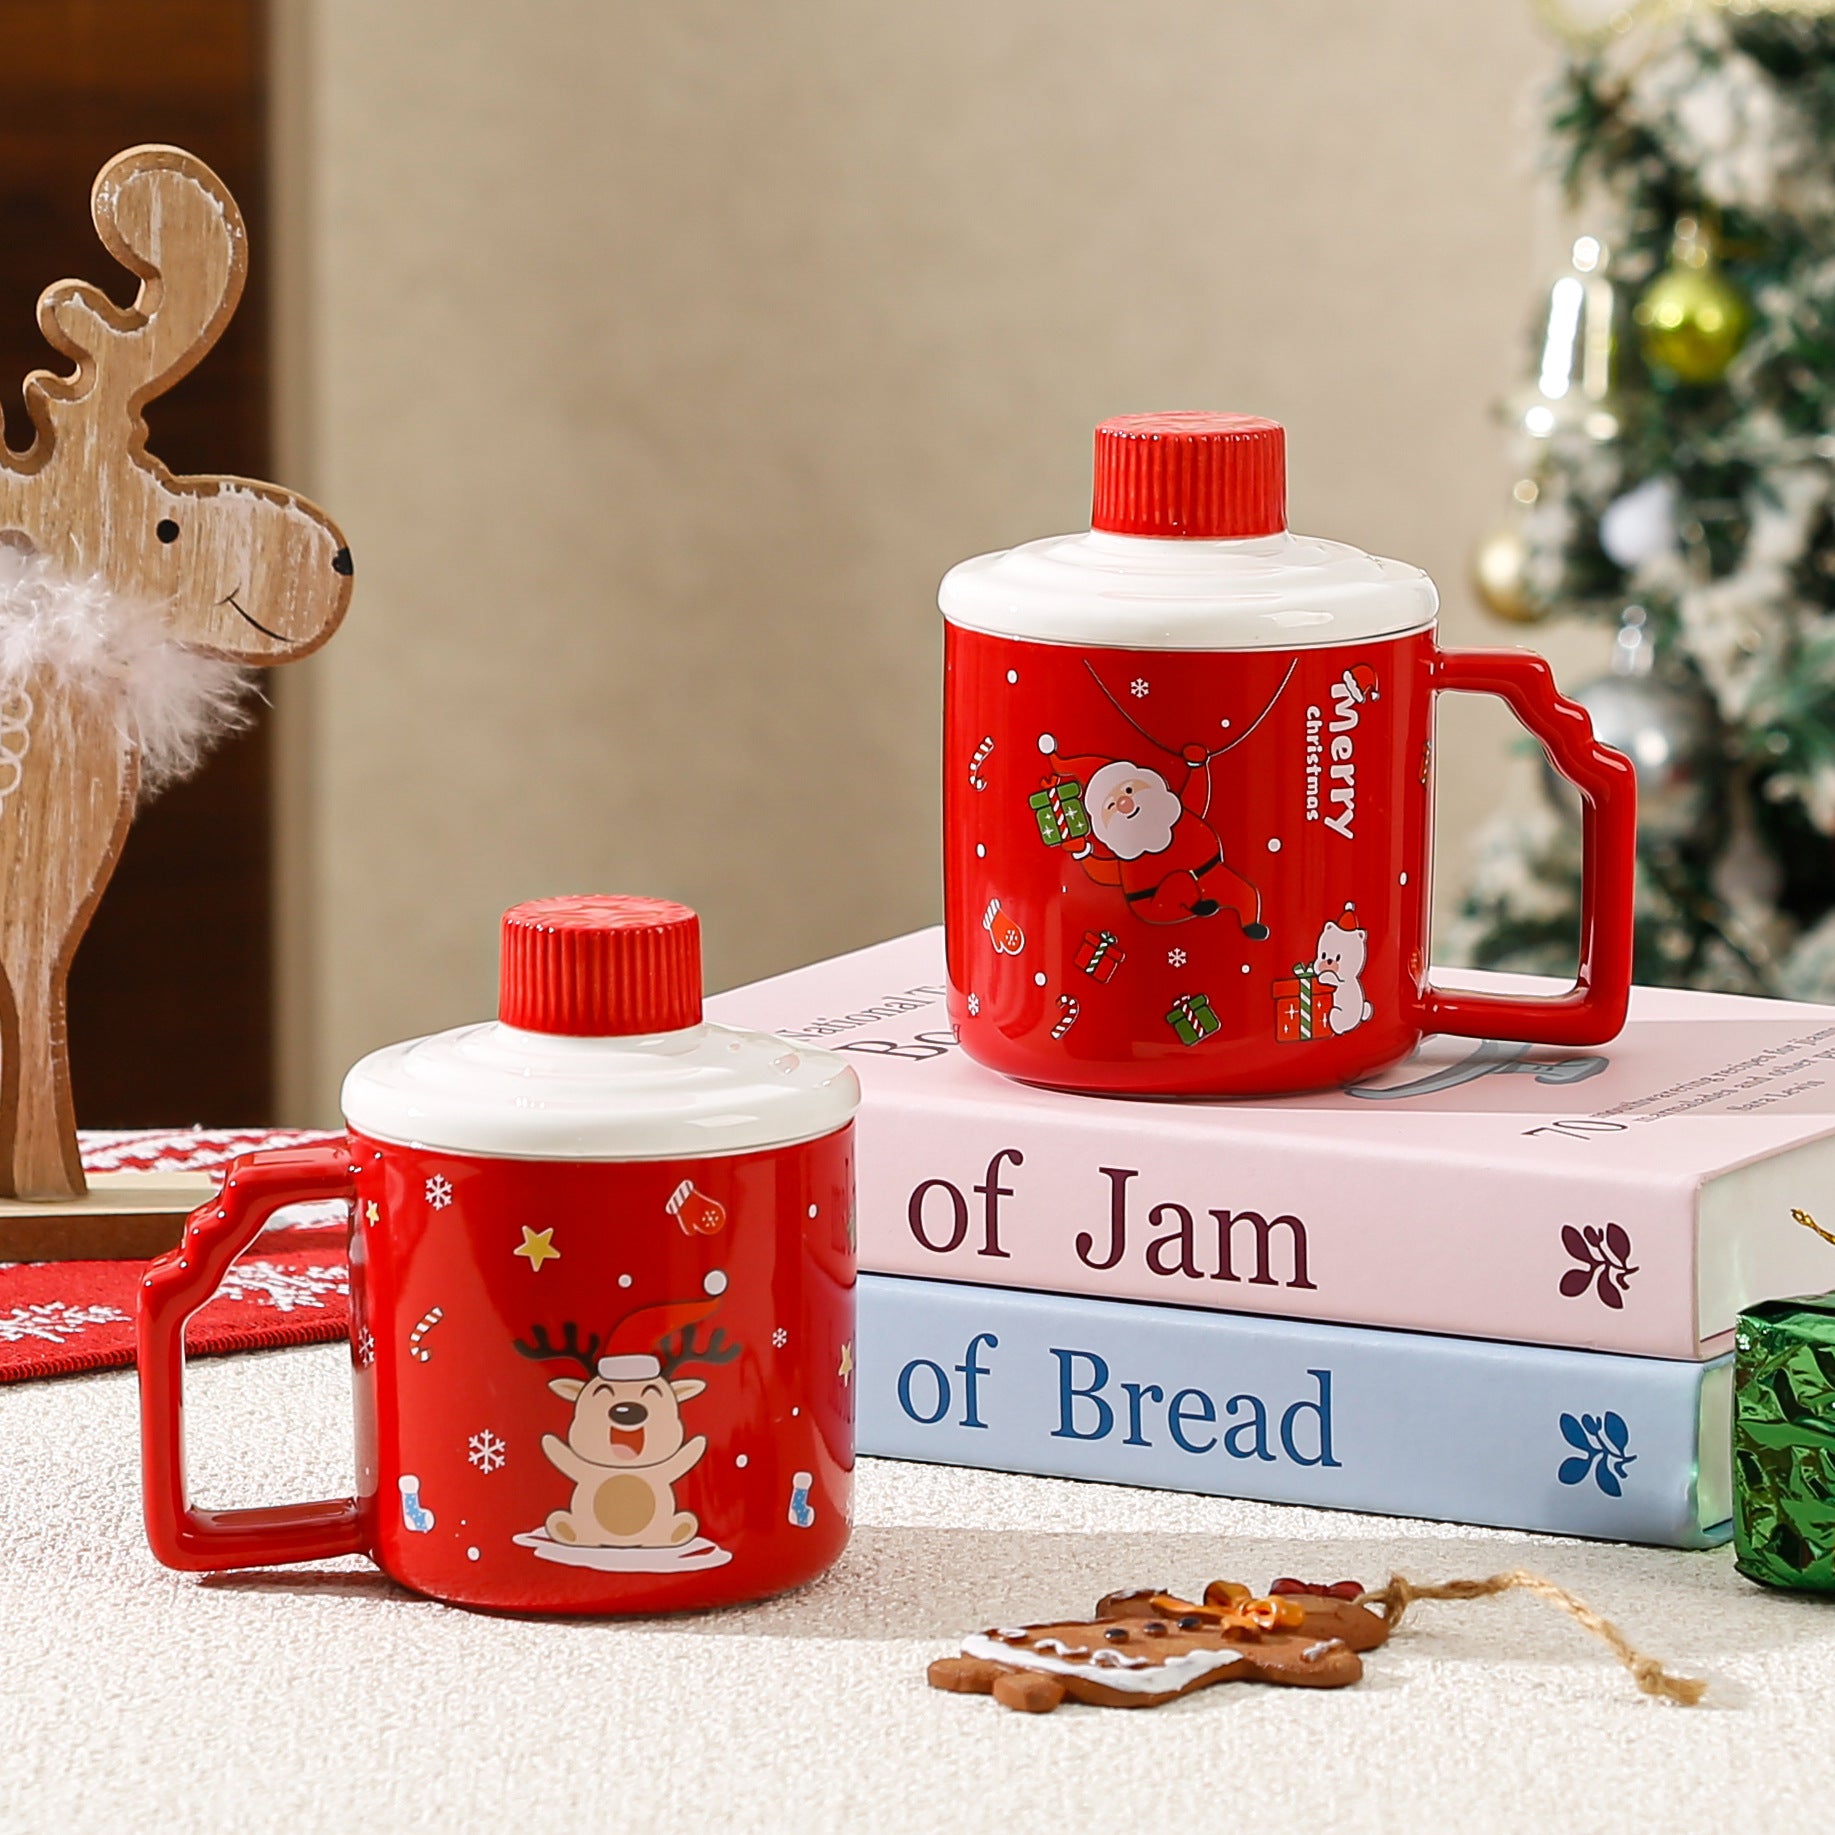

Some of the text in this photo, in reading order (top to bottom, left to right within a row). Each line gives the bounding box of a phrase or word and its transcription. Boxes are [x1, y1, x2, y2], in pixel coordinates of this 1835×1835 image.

[1306, 704, 1324, 822] christmas
[1324, 681, 1360, 840] Merry
[775, 984, 946, 1043] National T
[1520, 1118, 1628, 1141] 70
[907, 1148, 1318, 1291] of Jam
[897, 1332, 1343, 1468] of Bread
